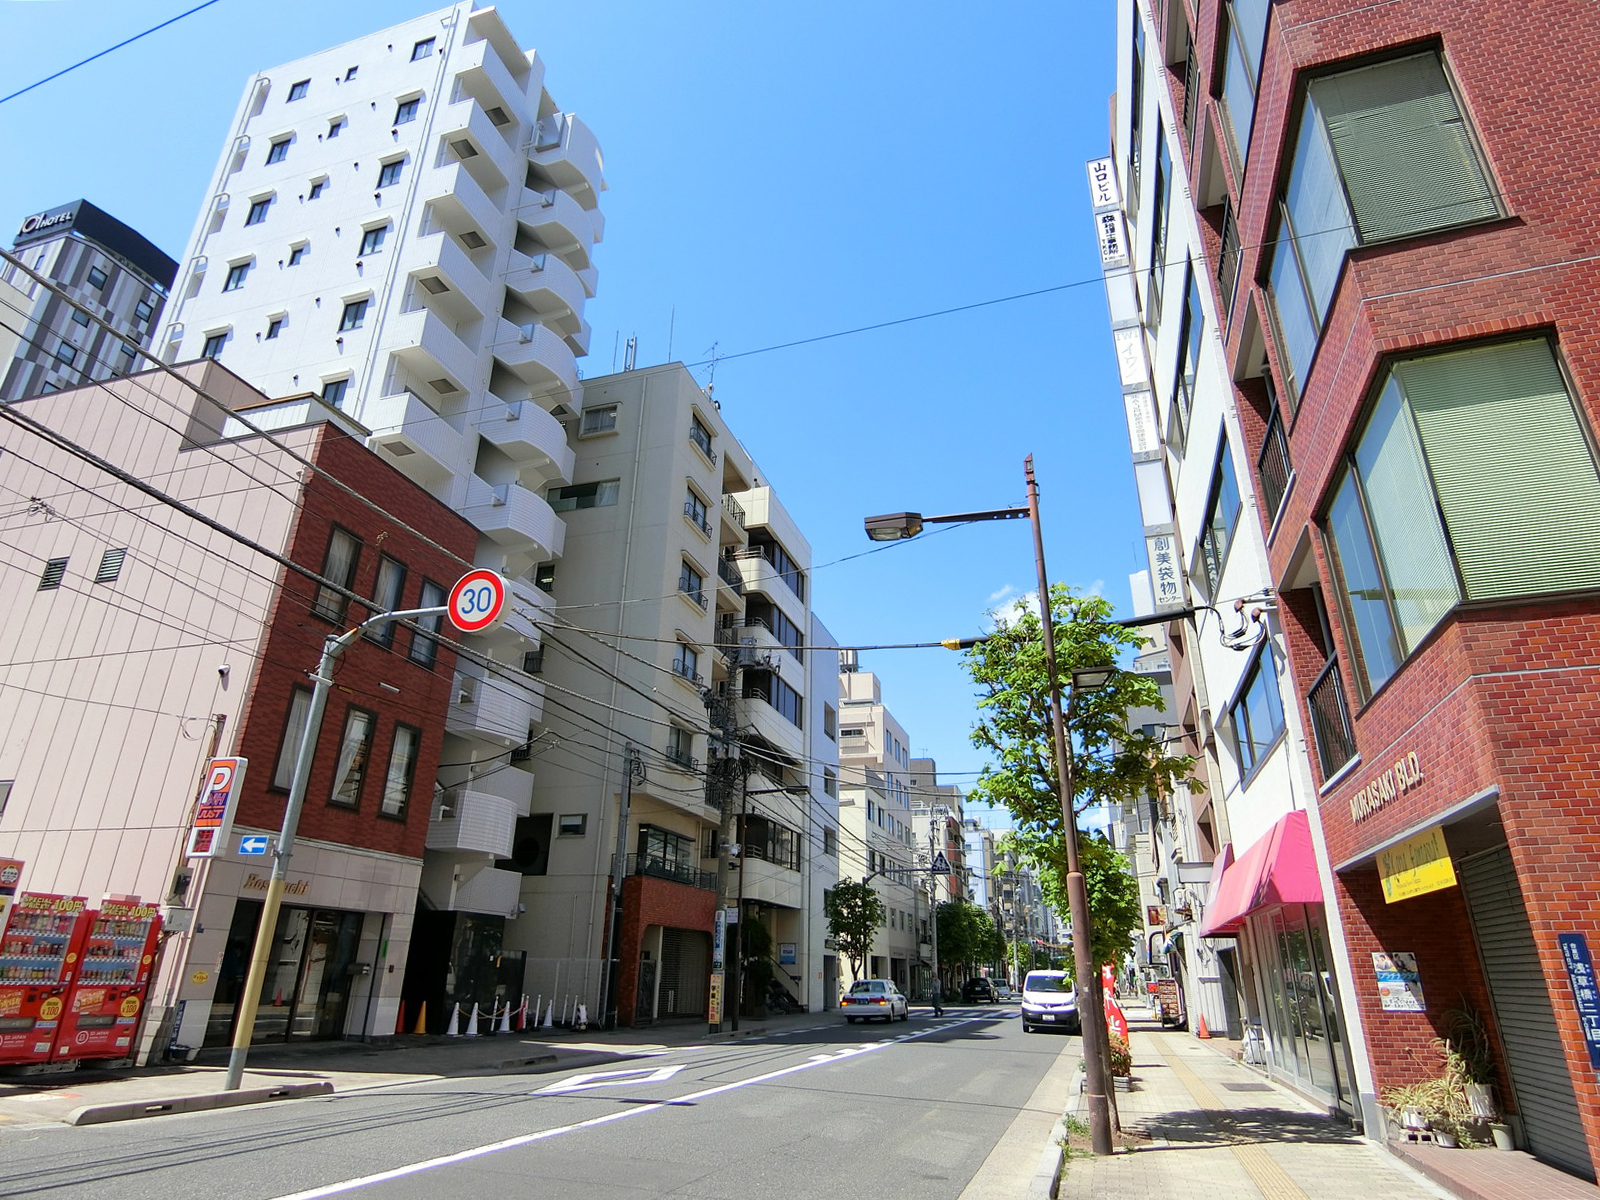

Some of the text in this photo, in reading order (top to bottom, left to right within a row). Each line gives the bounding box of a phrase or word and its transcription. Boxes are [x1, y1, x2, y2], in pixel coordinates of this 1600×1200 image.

[1094, 162, 1111, 202] 山口ビル
[40, 211, 71, 228] HOTEL
[1154, 536, 1177, 595] 創美袋物
[461, 586, 492, 614] 30
[1349, 751, 1424, 823] MURASAKI BLD.
[198, 809, 223, 818] JUST
[54, 899, 83, 912] 100円
[130, 906, 156, 918] 100円
[1574, 962, 1600, 1041] 浅草橋二丁目
